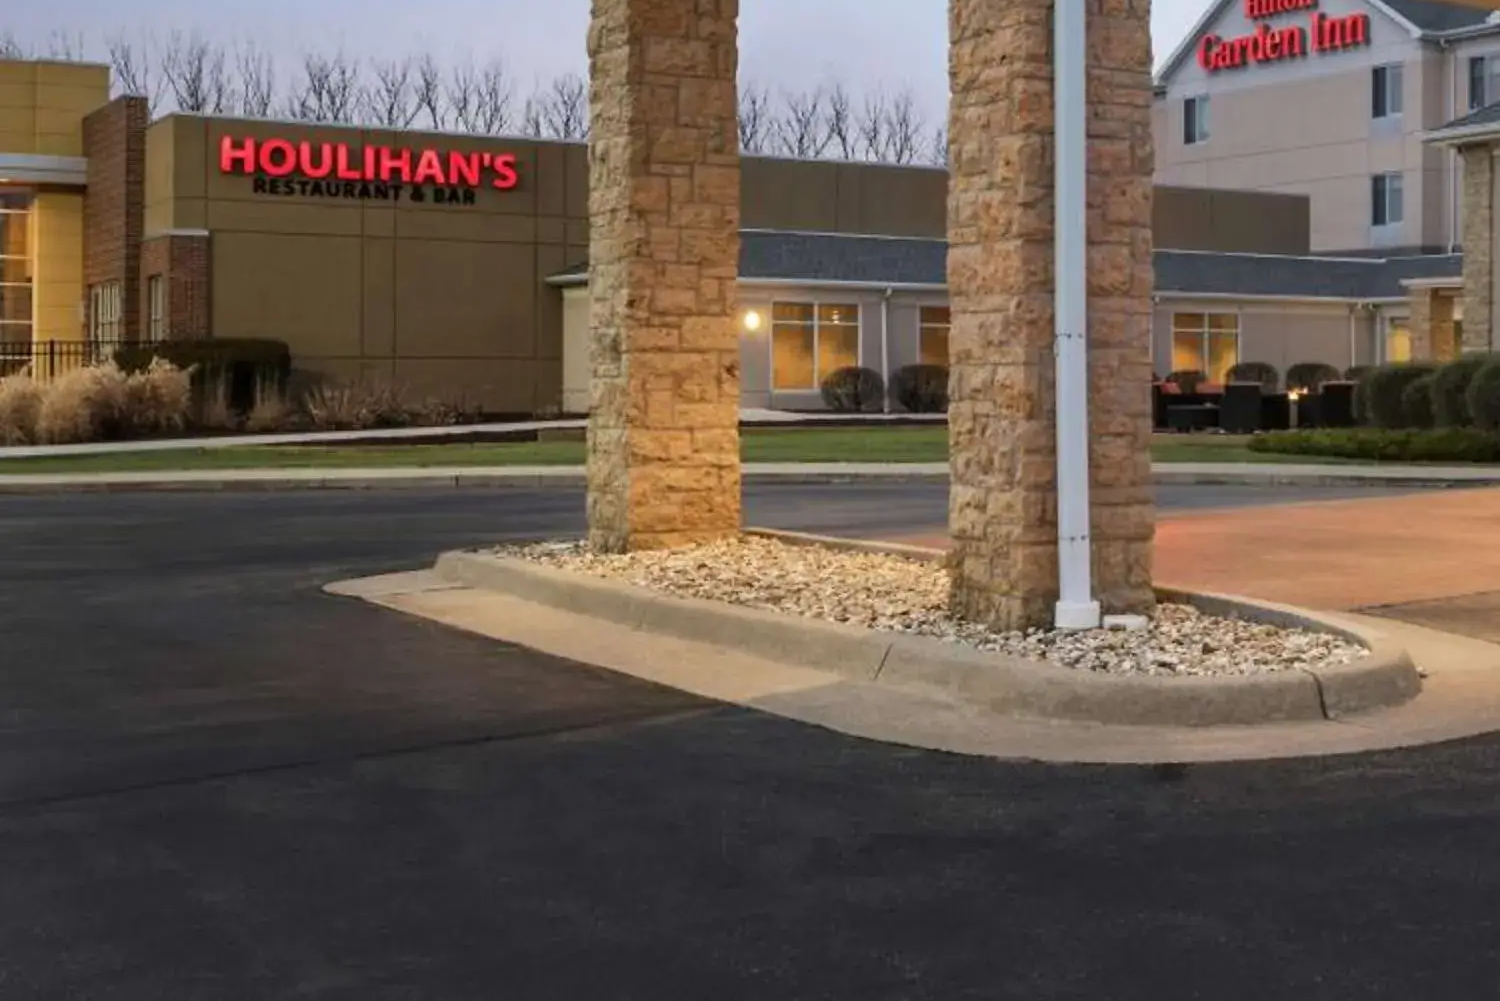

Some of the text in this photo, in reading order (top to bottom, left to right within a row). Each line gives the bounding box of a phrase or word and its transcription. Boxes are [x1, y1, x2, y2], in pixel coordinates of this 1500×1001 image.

[1197, 10, 1368, 74] Garden Inn
[220, 135, 519, 189] HOULIHAN'S
[253, 178, 402, 201] RESTAURANT
[434, 187, 475, 205] BAR
